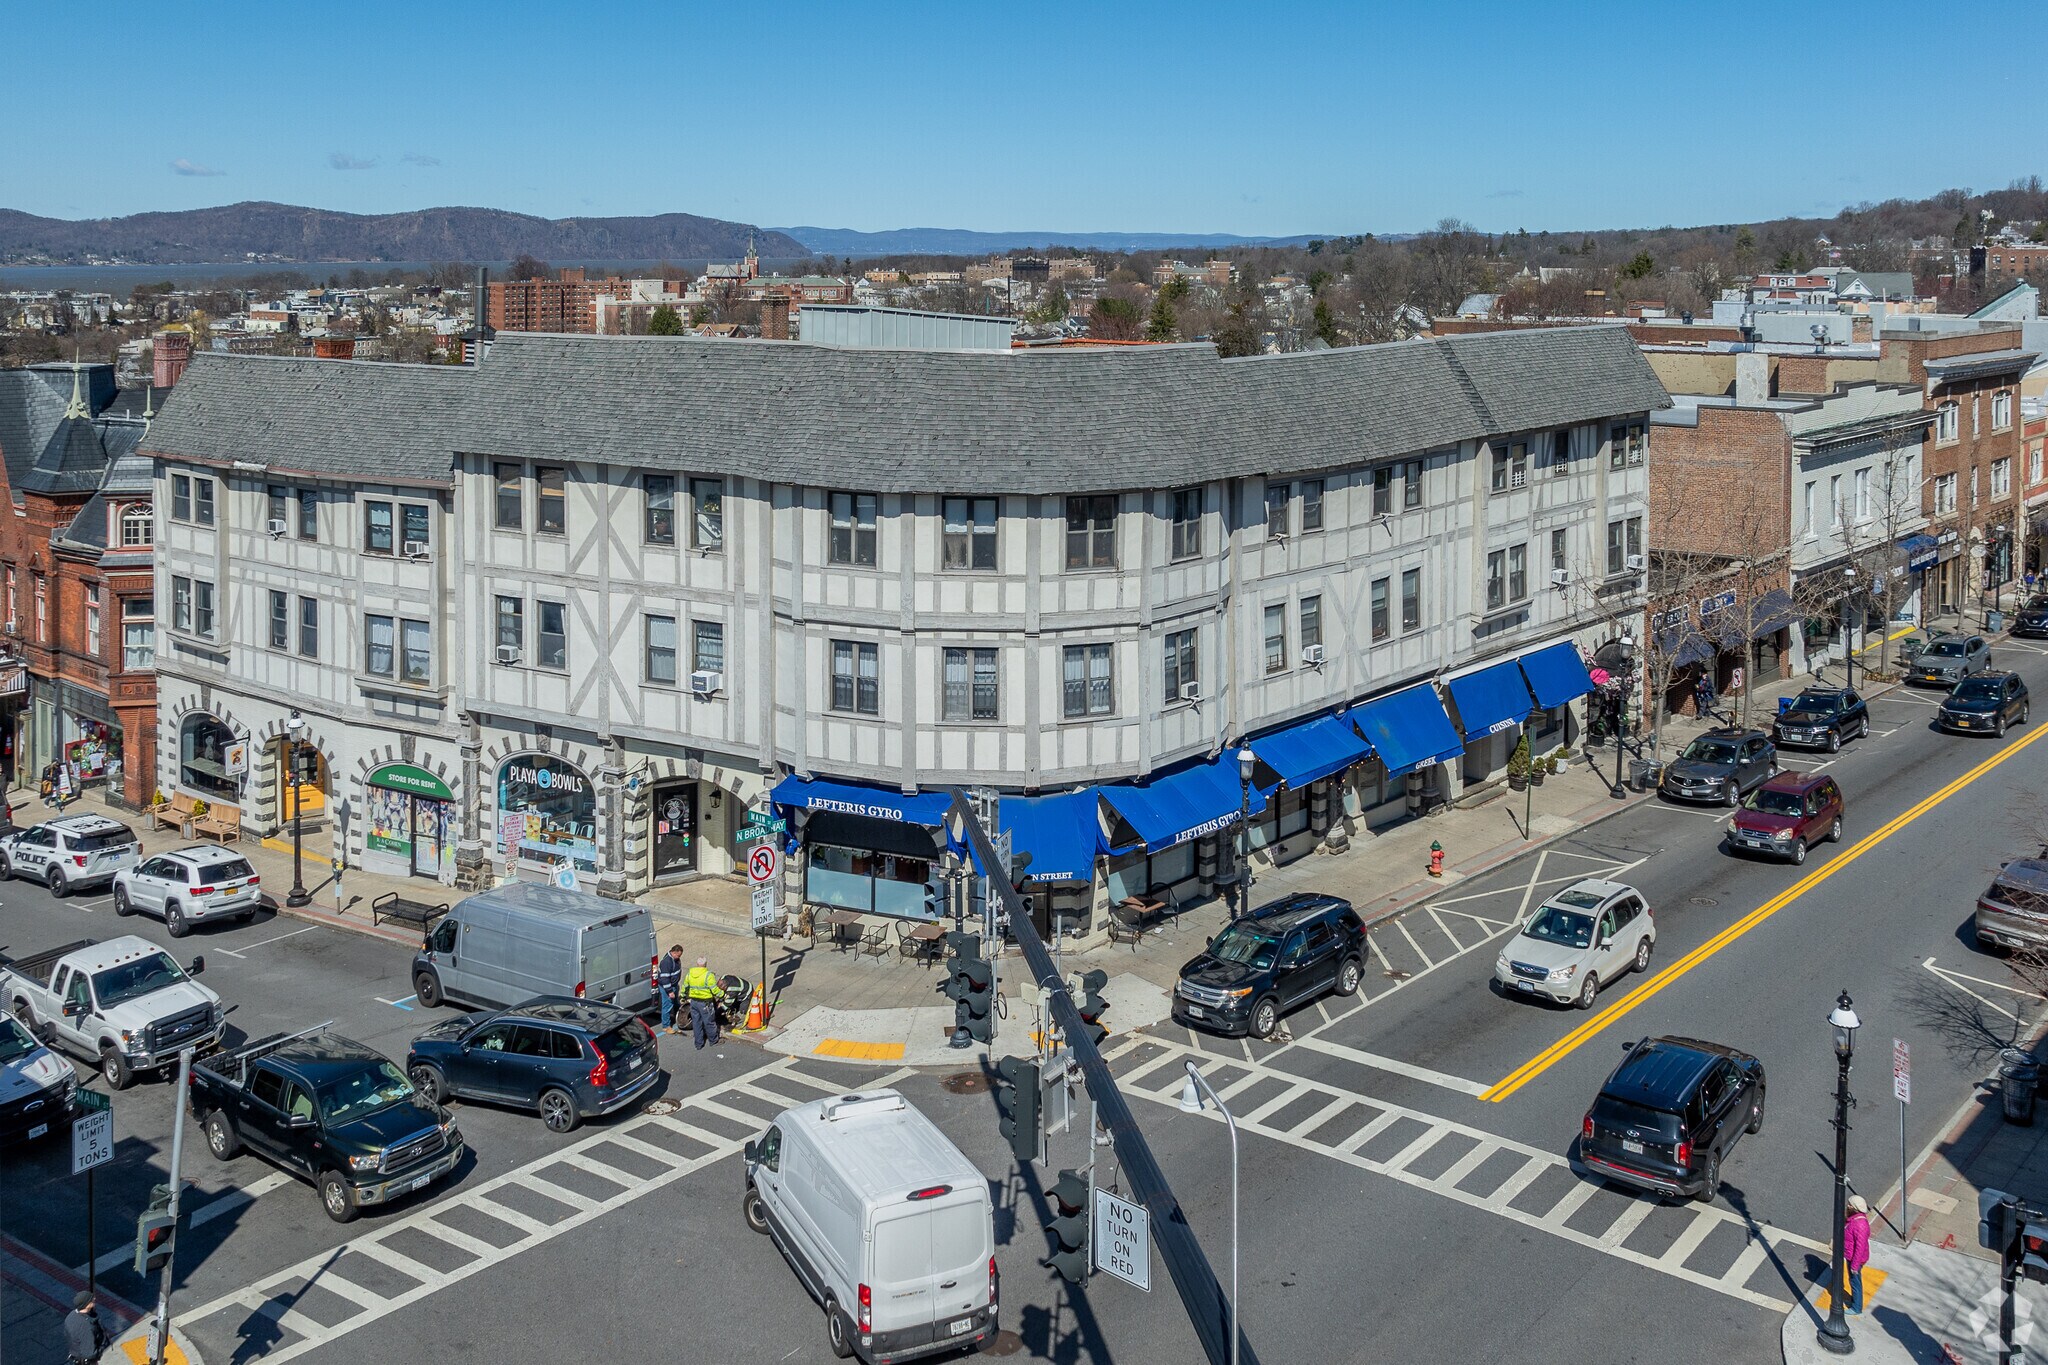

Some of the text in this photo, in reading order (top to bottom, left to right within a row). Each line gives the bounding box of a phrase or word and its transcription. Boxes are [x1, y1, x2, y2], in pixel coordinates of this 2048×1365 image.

[1489, 717, 1516, 733] CUISINE
[1415, 756, 1437, 770] GREEK
[388, 773, 437, 789] STORE FOR RENT
[510, 766, 583, 792] PLAYA BOWLS
[807, 797, 903, 819] LEFTERIS GYRO
[750, 812, 766, 823] MAIN
[1175, 811, 1241, 843] LEFTERIS GYRO
[736, 832, 743, 841] N
[15, 851, 47, 865] POLICE
[1040, 872, 1074, 880] STREET
[753, 888, 773, 899] WEIGHT
[756, 896, 770, 906] LIMIT
[761, 906, 766, 914] 5
[755, 913, 773, 926] TONS
[76, 1090, 100, 1107] MAIN
[77, 1113, 109, 1132] WEIGHT
[81, 1125, 105, 1141] LIMIT
[90, 1139, 97, 1150] 5
[79, 1147, 108, 1167] TONS
[1110, 1201, 1133, 1224] NO
[1106, 1219, 1138, 1245] TURN
[1114, 1241, 1130, 1258] ON
[1111, 1255, 1134, 1276] RED
